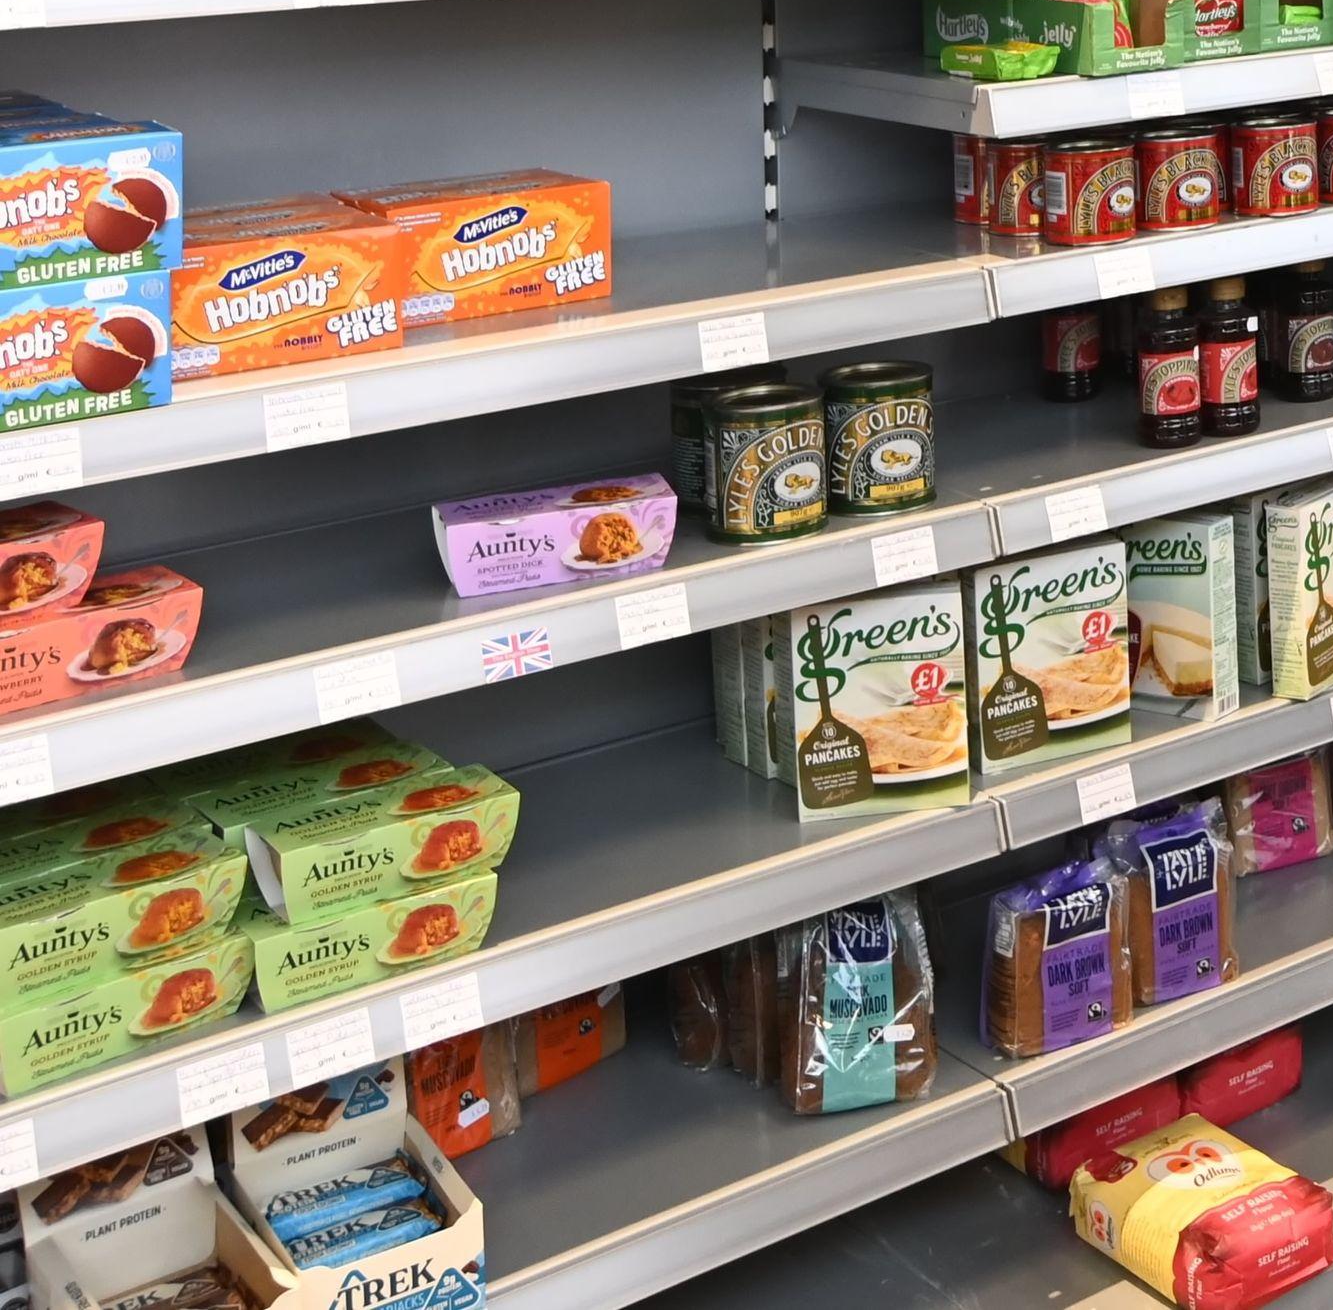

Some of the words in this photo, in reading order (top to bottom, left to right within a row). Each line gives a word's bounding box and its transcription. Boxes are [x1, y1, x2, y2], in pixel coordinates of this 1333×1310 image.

[938, 8, 989, 40] Hartley's
[1039, 20, 1077, 50] jelly
[1281, 27, 1294, 35] The
[1121, 52, 1134, 60] The
[1200, 41, 1213, 49] The
[462, 208, 519, 242] McVitie's
[16, 256, 91, 285] GLUTEN
[95, 250, 144, 274] FREE
[441, 220, 557, 283] Hobnobs
[544, 250, 605, 283] GLUTEN
[230, 253, 296, 290] McVitie's
[555, 265, 606, 296] FREE
[203, 265, 340, 333] Hobnobs
[326, 298, 397, 333] GLUTEN
[284, 334, 323, 348] NOBBLY
[338, 316, 399, 349] FREE
[5, 397, 80, 427] GLUTEN
[84, 388, 132, 414] FREE
[854, 404, 928, 437] GOLDEN
[757, 425, 824, 462] GOLDEN
[467, 534, 555, 563] Aunty's
[477, 563, 520, 576] SPOTTED
[520, 559, 544, 571] DICK
[979, 556, 1117, 659] Green's
[1083, 614, 1108, 639] £1
[795, 605, 951, 703] Green's
[914, 669, 940, 691] £1
[987, 695, 1038, 720] PANCAKES
[825, 727, 834, 737] 10
[804, 745, 861, 766] PANCAKES
[275, 799, 383, 835] Aunty's
[302, 847, 395, 888] Aunty's
[1166, 862, 1208, 891] LYLE
[310, 881, 351, 899] GOLDEN
[352, 873, 384, 888] SYRUP
[1060, 902, 1101, 930] LYLE
[1159, 924, 1183, 947] DARK
[1184, 916, 1214, 941] BROWN
[8, 922, 110, 972] Aunty's
[276, 933, 371, 977] Aunty's
[1177, 937, 1197, 955] SOFT
[17, 961, 63, 982] GOLDEN
[63, 950, 98, 970] SYRUP
[285, 969, 326, 987] GOLDEN
[327, 959, 360, 976] SYRUP
[1047, 962, 1073, 987] DARK
[1075, 952, 1106, 980] BROWN
[1069, 979, 1090, 997] SOFT
[22, 1006, 122, 1058] Aunty's
[30, 1047, 75, 1068] GOLDEN
[76, 1033, 110, 1054] SYRUP
[1228, 1072, 1245, 1087] SELF
[1246, 1060, 1274, 1080] RAISING
[1095, 1121, 1112, 1136] SELF
[1113, 1107, 1144, 1129] RAISING
[287, 1150, 317, 1167] PLANT
[319, 1137, 357, 1156] PROTEIN
[1193, 1163, 1241, 1188] Odlums
[85, 1221, 117, 1242] PLANT
[120, 1206, 162, 1230] PROTEIN
[1258, 1250, 1276, 1268] SELF
[1277, 1236, 1310, 1260] RAISING
[337, 1258, 436, 1310] TREK
